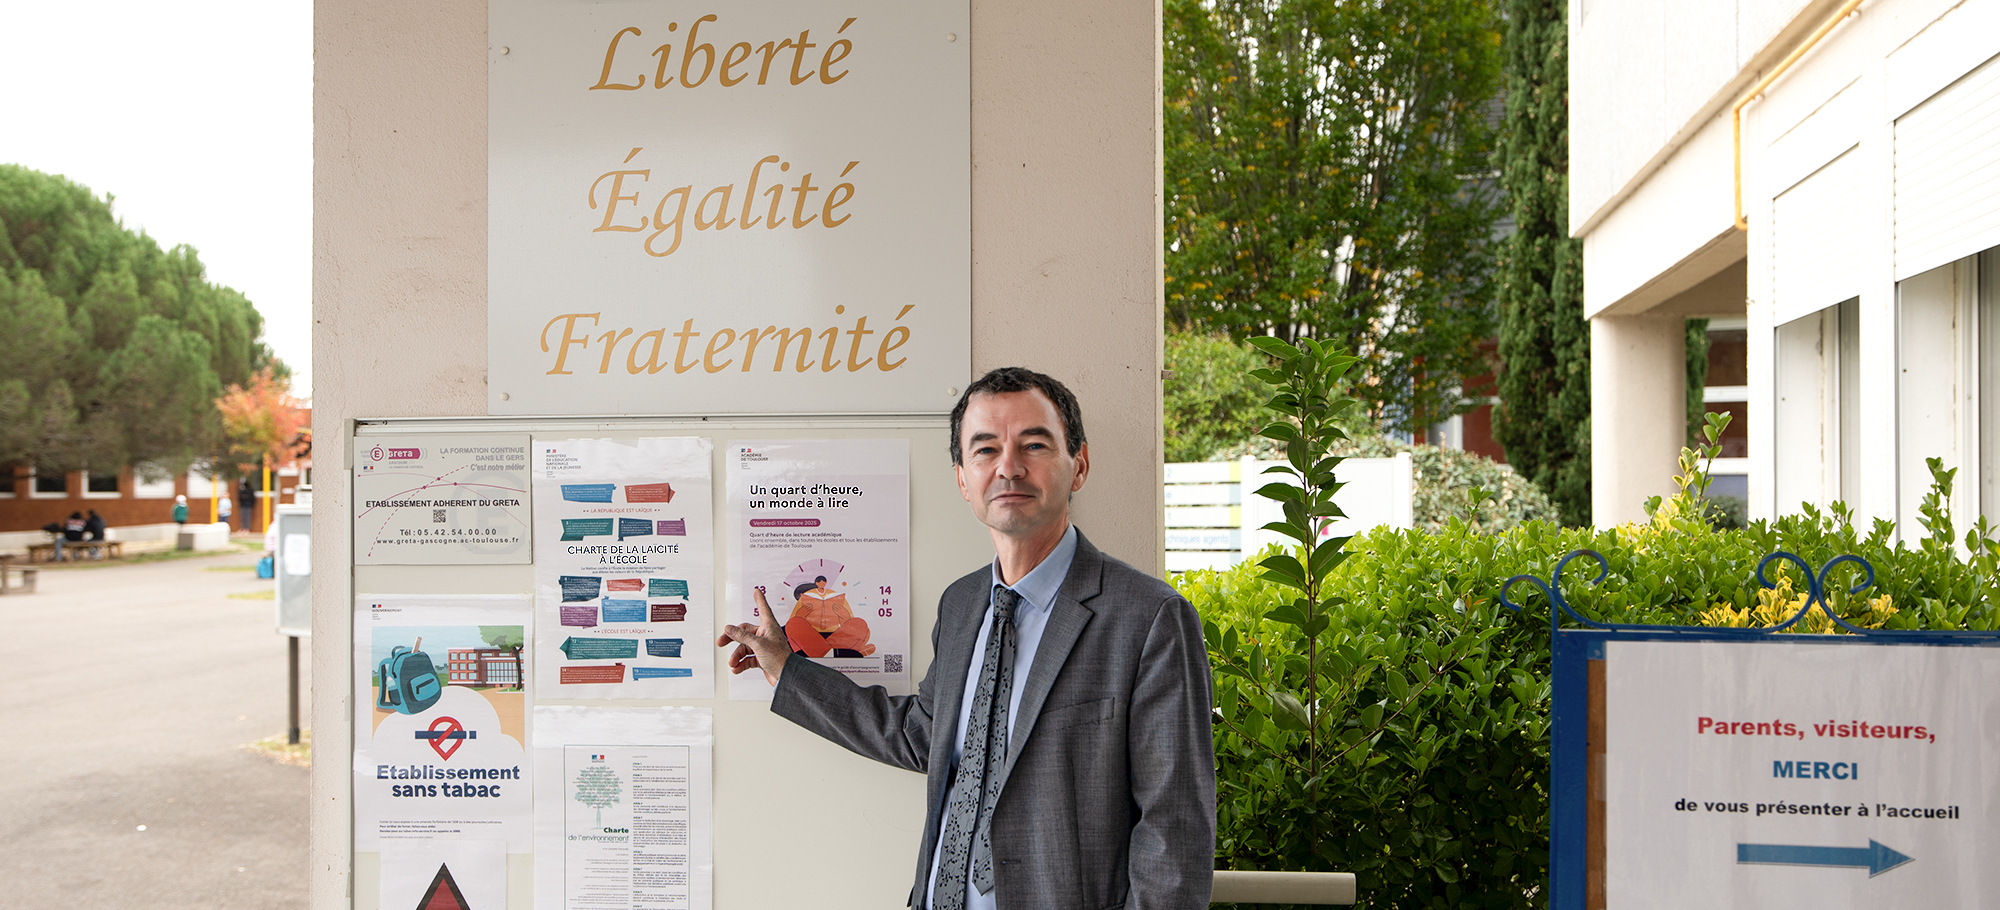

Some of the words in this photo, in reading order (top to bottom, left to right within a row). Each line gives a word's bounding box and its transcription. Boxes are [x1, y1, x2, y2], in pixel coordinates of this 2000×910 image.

[589, 14, 857, 91] Liberté
[588, 147, 860, 258] Égalité
[540, 304, 915, 376] Fraternité
[470, 463, 487, 471] C'est
[505, 463, 525, 471] métier
[750, 485, 767, 495] Un
[771, 485, 807, 498] quart
[810, 484, 863, 496] d'heure,
[365, 500, 432, 508] ETABLISSEMENT
[492, 499, 520, 507] GRETA
[750, 500, 765, 508] un
[769, 497, 813, 508] monde
[817, 497, 824, 508] à
[828, 497, 849, 508] lire
[567, 545, 607, 554] CHARTE
[610, 545, 623, 554] DE
[626, 545, 639, 554] LA
[642, 543, 679, 554] LAÏCITÉ
[599, 554, 607, 564] À
[610, 554, 648, 564] L'ÉCOLE
[879, 586, 892, 595] 14
[878, 607, 892, 617] 05
[1697, 716, 1805, 741] Parents,
[1813, 719, 1937, 744] visiteurs,
[377, 765, 520, 780] Etablissement
[1773, 760, 1859, 781] MERCI
[392, 784, 437, 797] sans
[441, 782, 501, 797] tabac
[1674, 798, 1698, 812] de
[1704, 802, 1749, 813] vous
[1756, 801, 1851, 817] présenter
[1857, 802, 1869, 817] à
[1876, 804, 1960, 820] l'accueil
